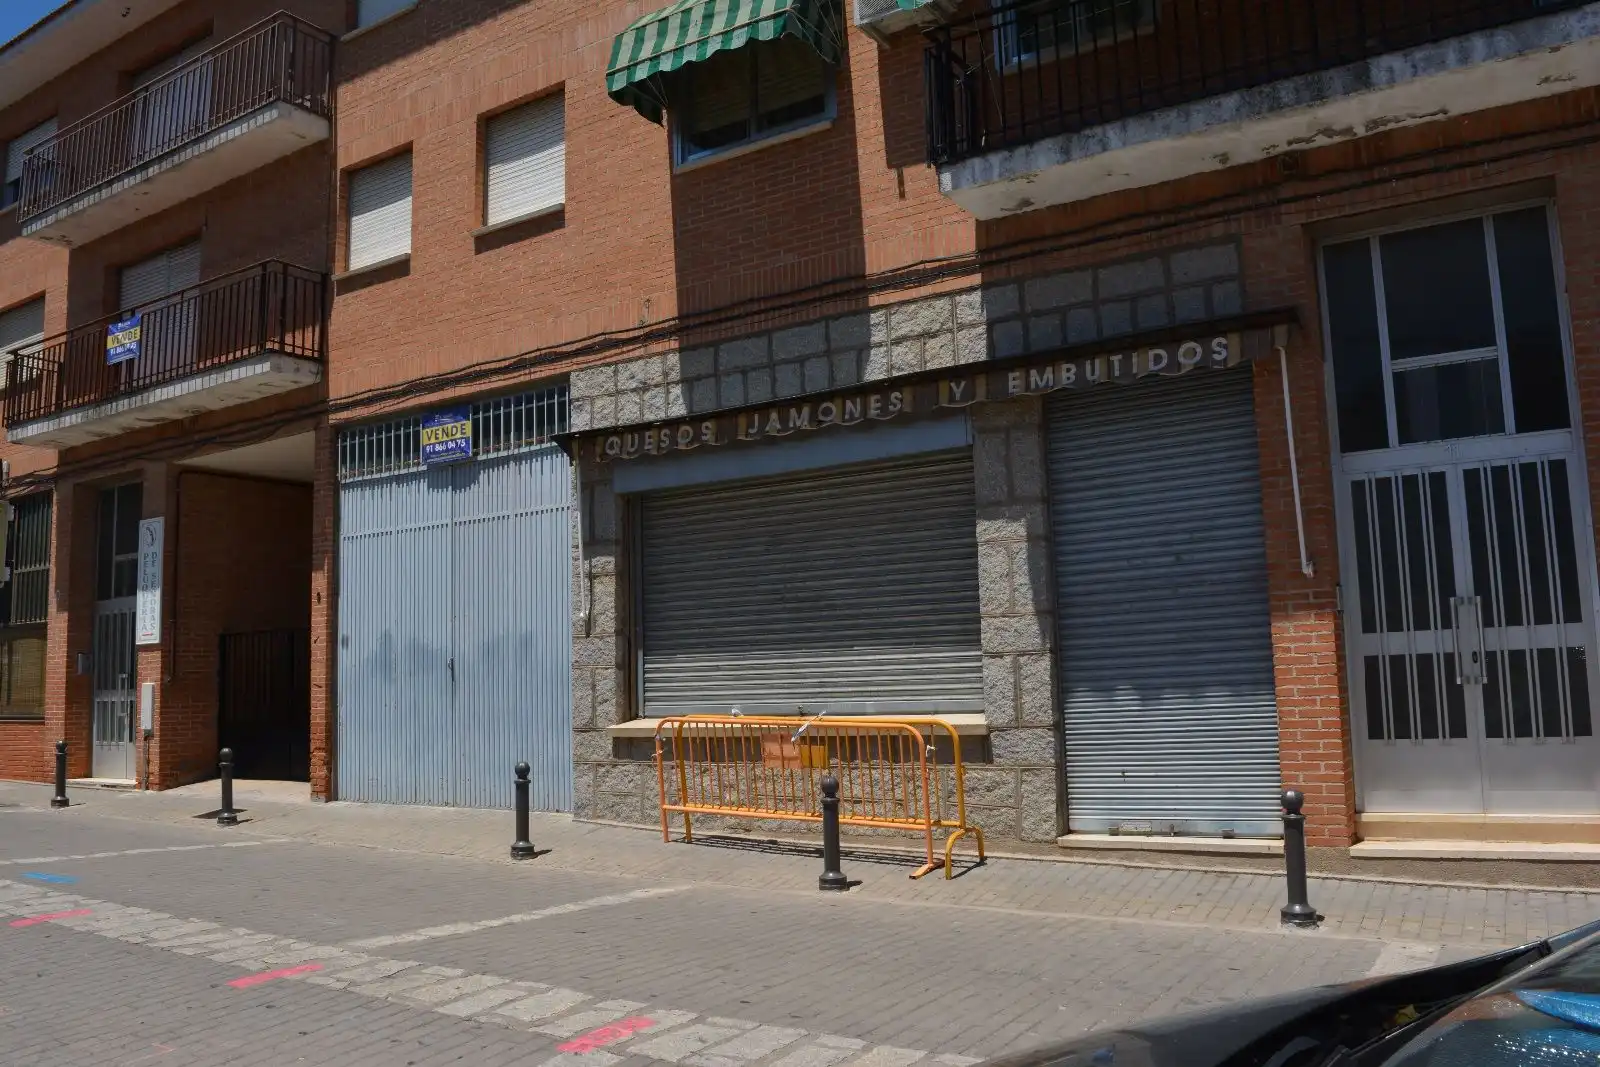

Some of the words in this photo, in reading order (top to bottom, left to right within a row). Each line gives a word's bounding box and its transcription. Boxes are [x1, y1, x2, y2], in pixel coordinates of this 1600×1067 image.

[111, 329, 138, 345] VENDE
[605, 421, 713, 456] QUESOS
[747, 391, 903, 434] JAMONES
[950, 381, 967, 400] Y
[1007, 337, 1229, 394] EMBUTIDOS
[426, 423, 466, 442] VENDE
[426, 445, 433, 453] 91
[435, 442, 446, 451] 866
[447, 441, 456, 449] 04
[456, 439, 466, 447] 75
[151, 551, 157, 568] DE
